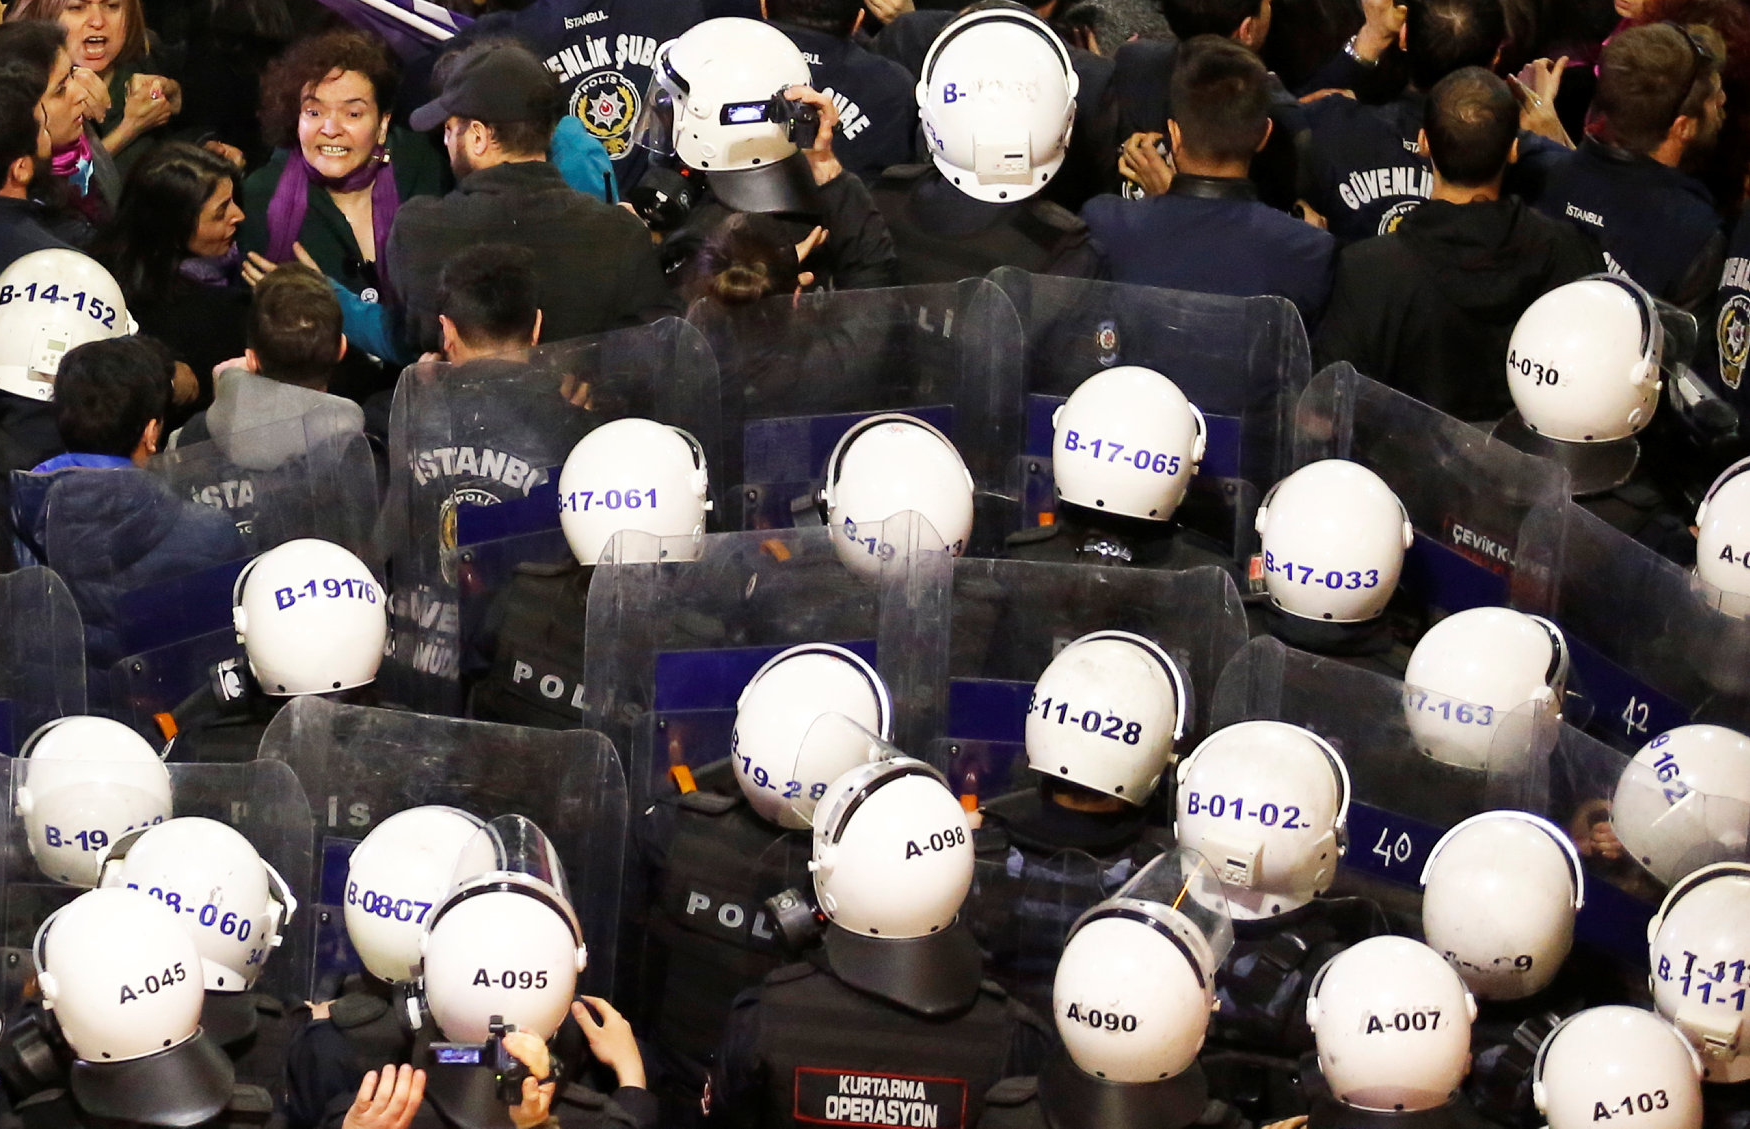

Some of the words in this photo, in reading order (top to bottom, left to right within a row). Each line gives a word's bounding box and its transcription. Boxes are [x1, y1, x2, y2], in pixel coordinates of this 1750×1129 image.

[563, 10, 609, 30] İSTANBUL
[1064, 430, 1181, 476] B-17-065
[1265, 550, 1379, 589] B-17-033
[1622, 696, 1648, 736] 42
[905, 826, 965, 860] A-098
[1372, 827, 1411, 866] 40
[686, 890, 774, 940] POL
[119, 962, 186, 1005] A-045
[472, 969, 548, 989] A-095
[1067, 1002, 1137, 1032] A-090
[1366, 1011, 1441, 1035] A-007
[839, 1075, 926, 1102] KURTARMA
[825, 1096, 939, 1129] OPERASYON
[1593, 1089, 1669, 1122] A-103
